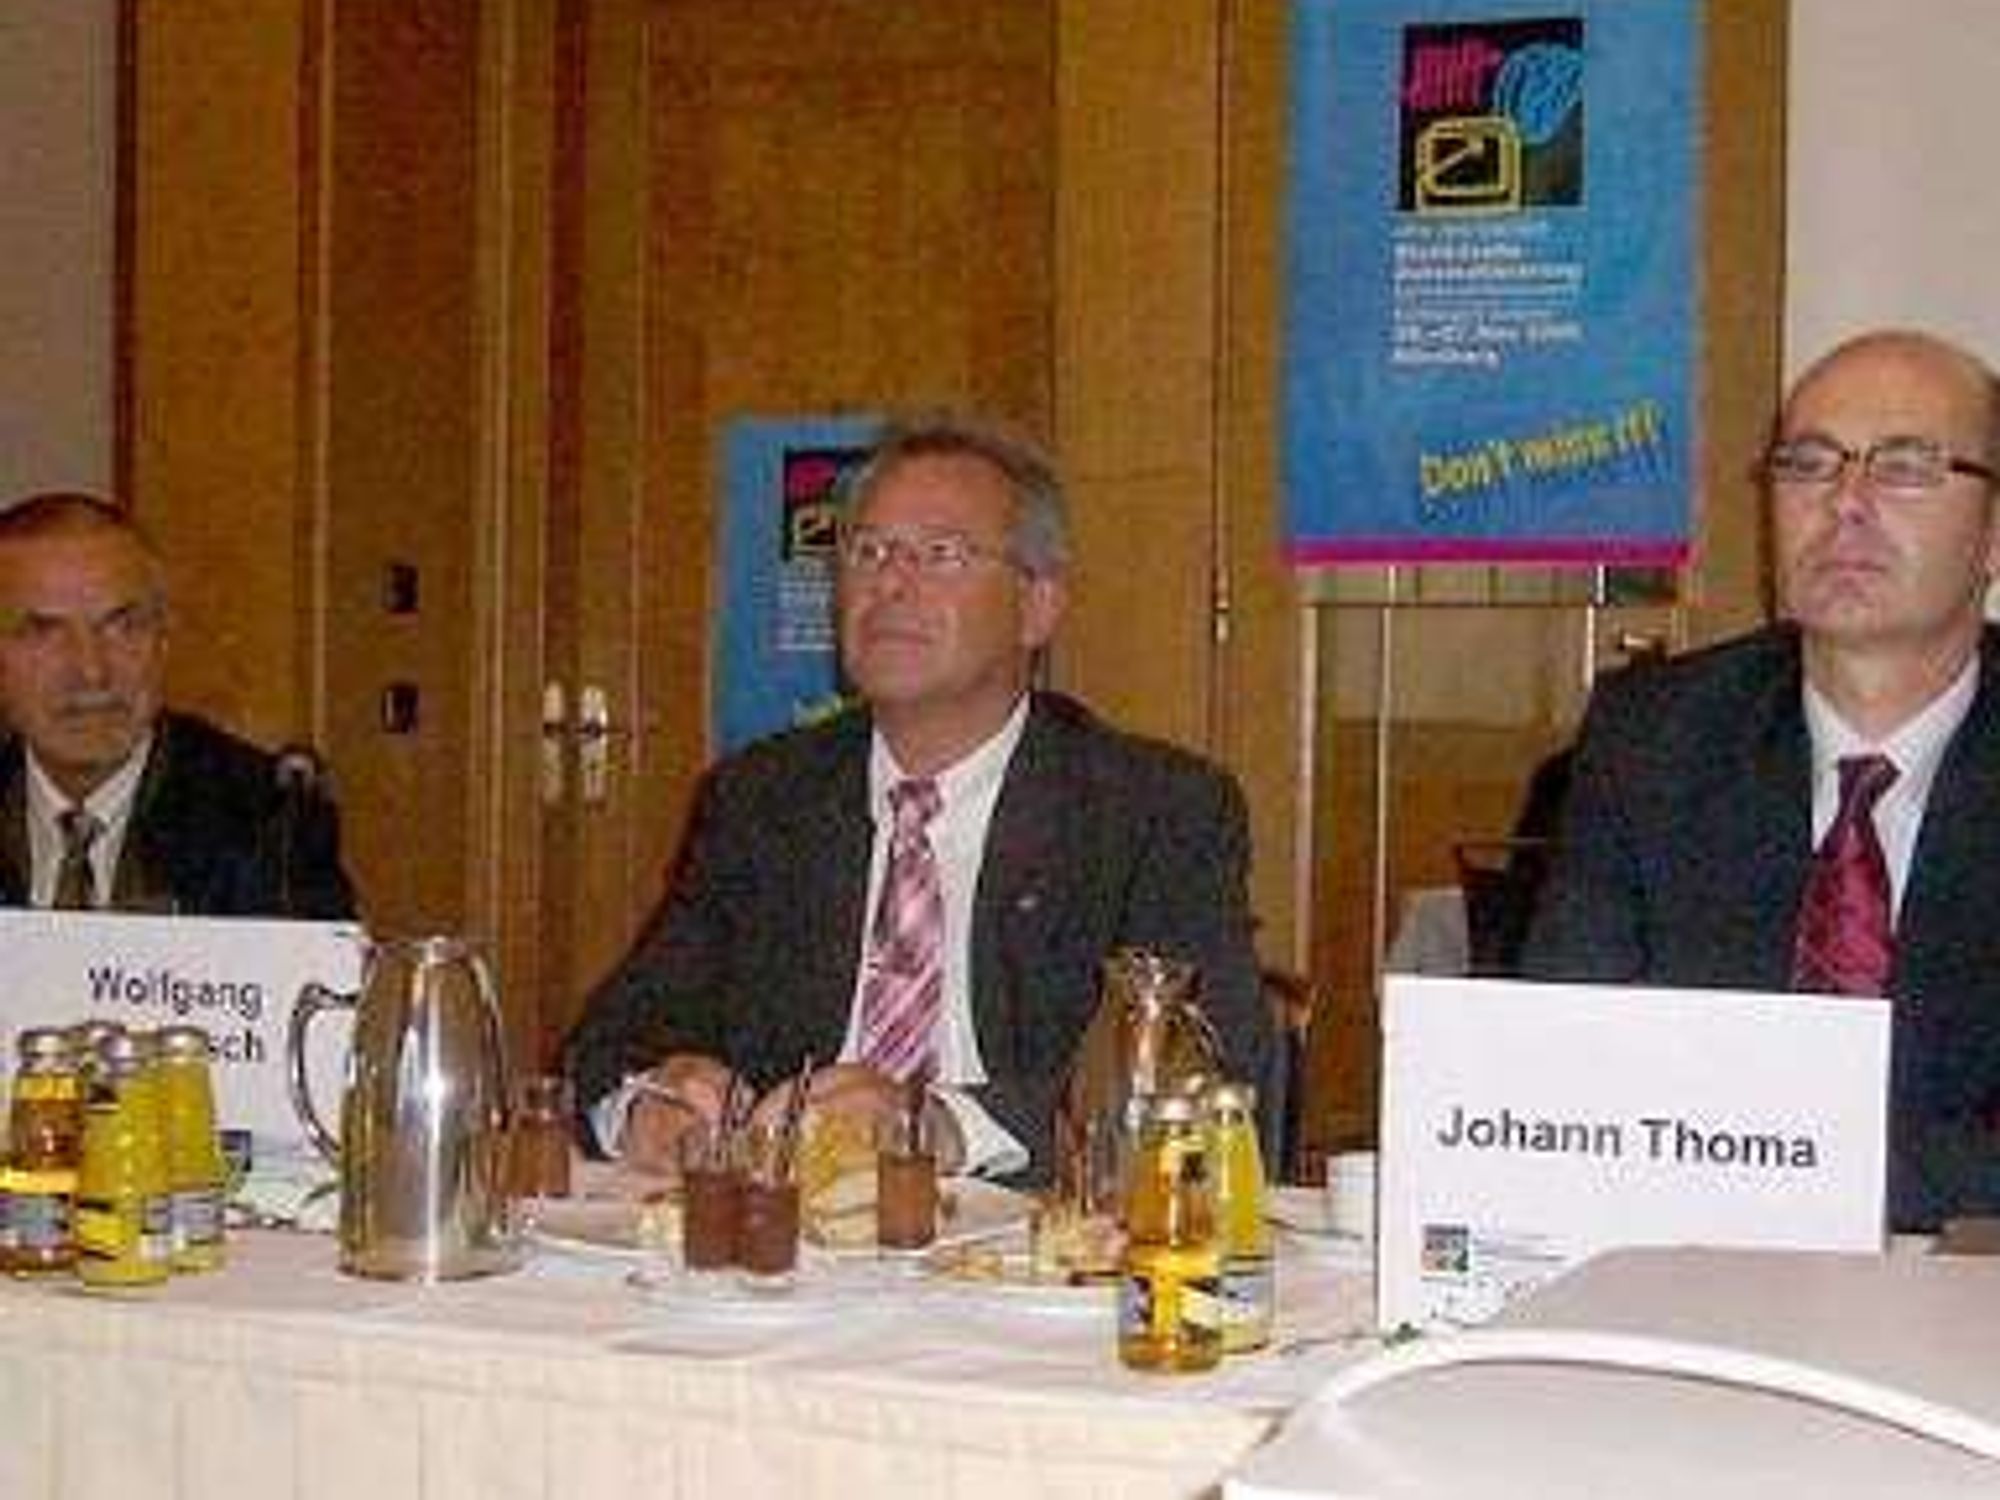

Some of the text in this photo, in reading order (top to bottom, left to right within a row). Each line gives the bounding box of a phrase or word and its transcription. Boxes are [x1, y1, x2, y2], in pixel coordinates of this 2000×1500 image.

[88, 966, 262, 1020] Wolfgang
[208, 1028, 264, 1063] sch
[1437, 1106, 1820, 1169] Johann Thoma
